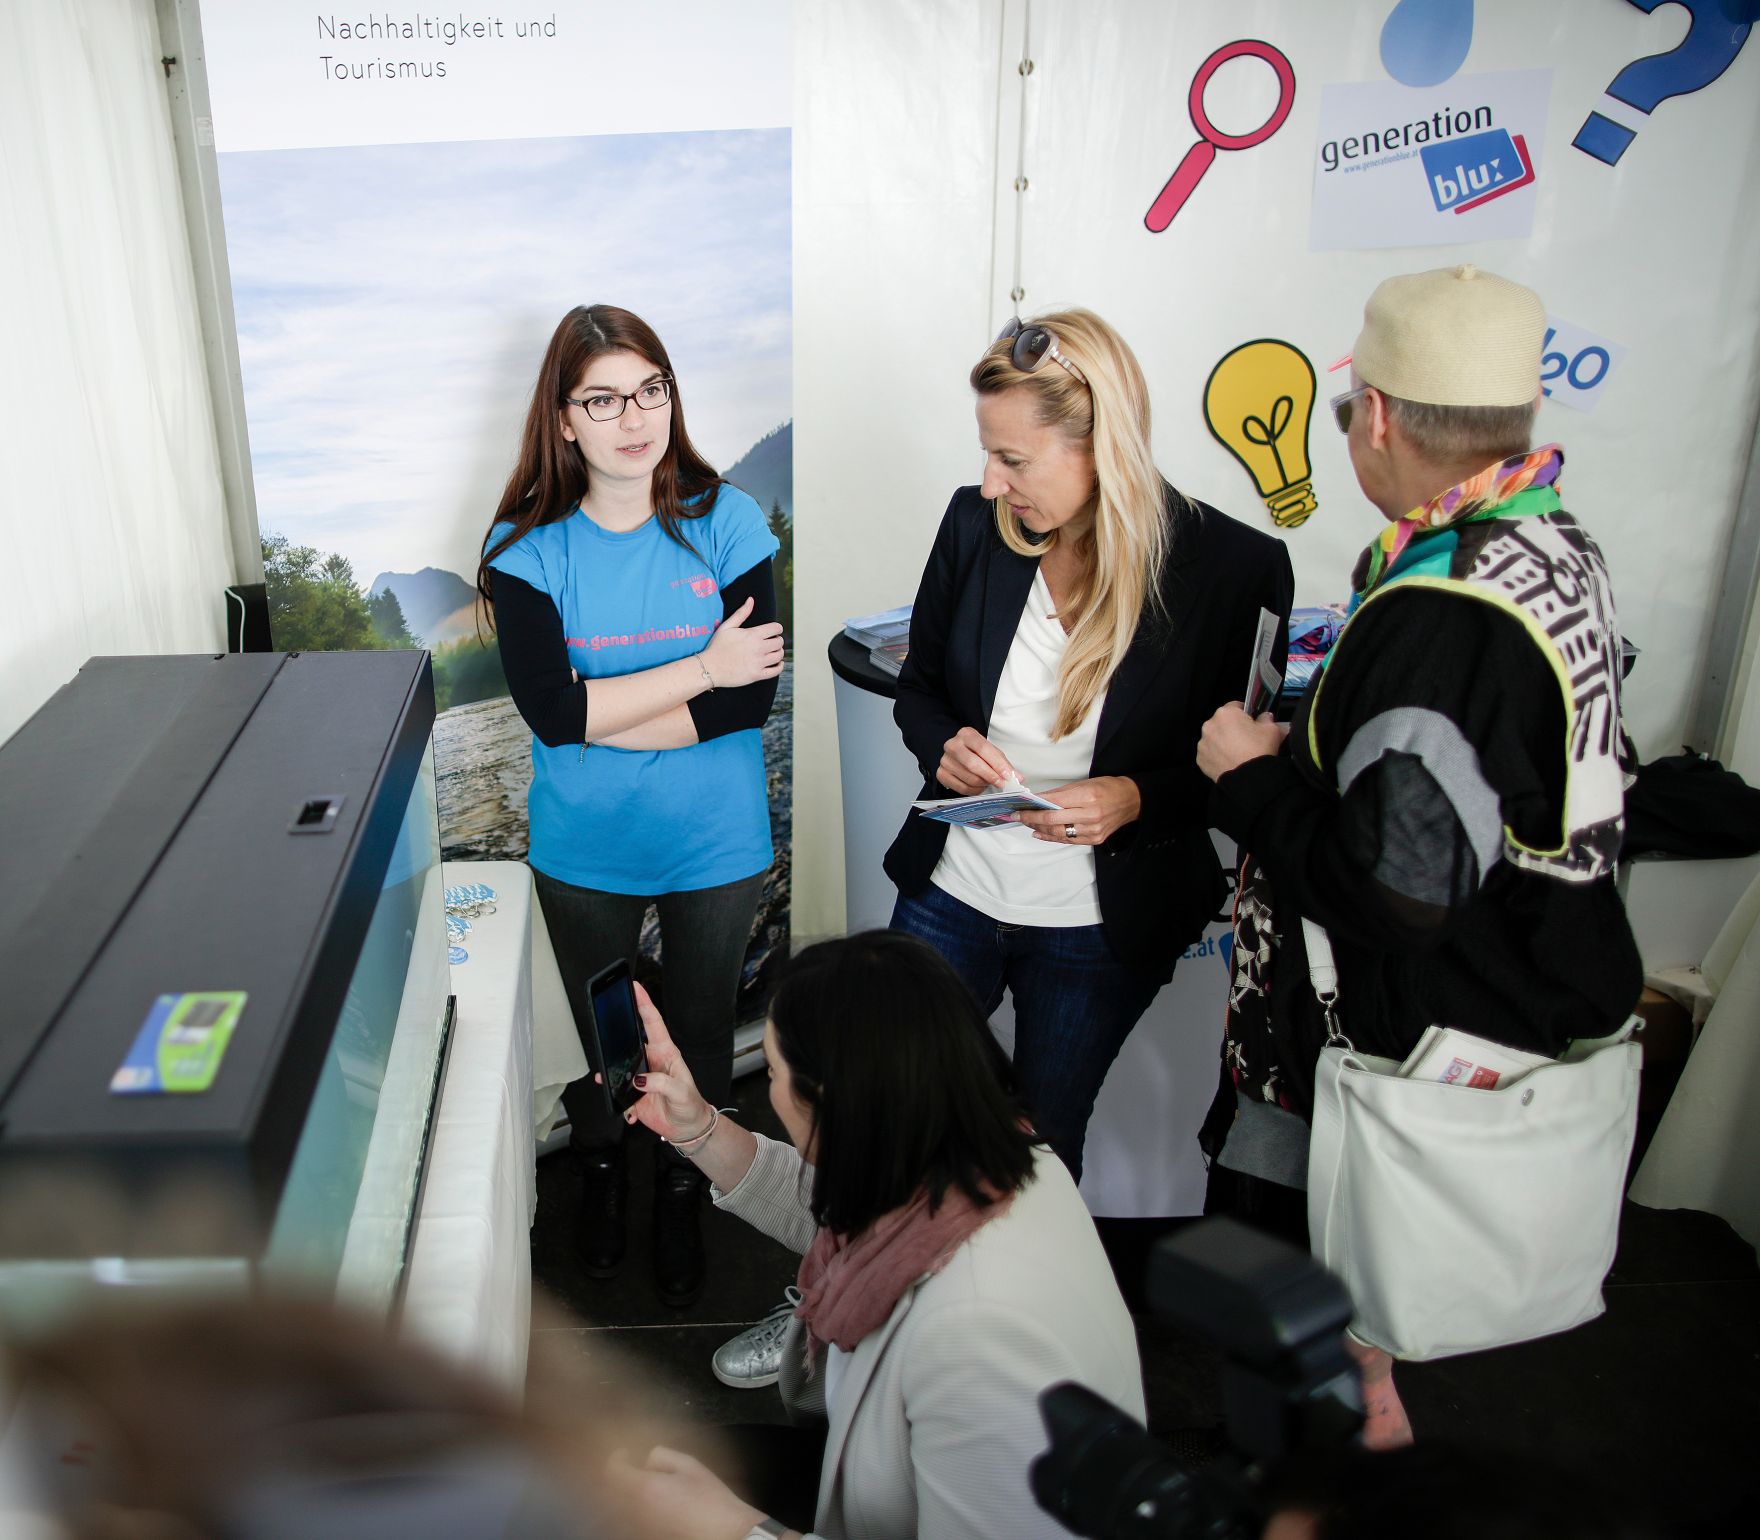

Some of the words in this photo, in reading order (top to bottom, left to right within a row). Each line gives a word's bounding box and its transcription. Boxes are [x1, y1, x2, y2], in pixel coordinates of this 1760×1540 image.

[317, 13, 504, 46] Nachhaltigkeit
[515, 13, 557, 38] und
[319, 56, 447, 80] Tourismus
[1321, 105, 1493, 172] generation
